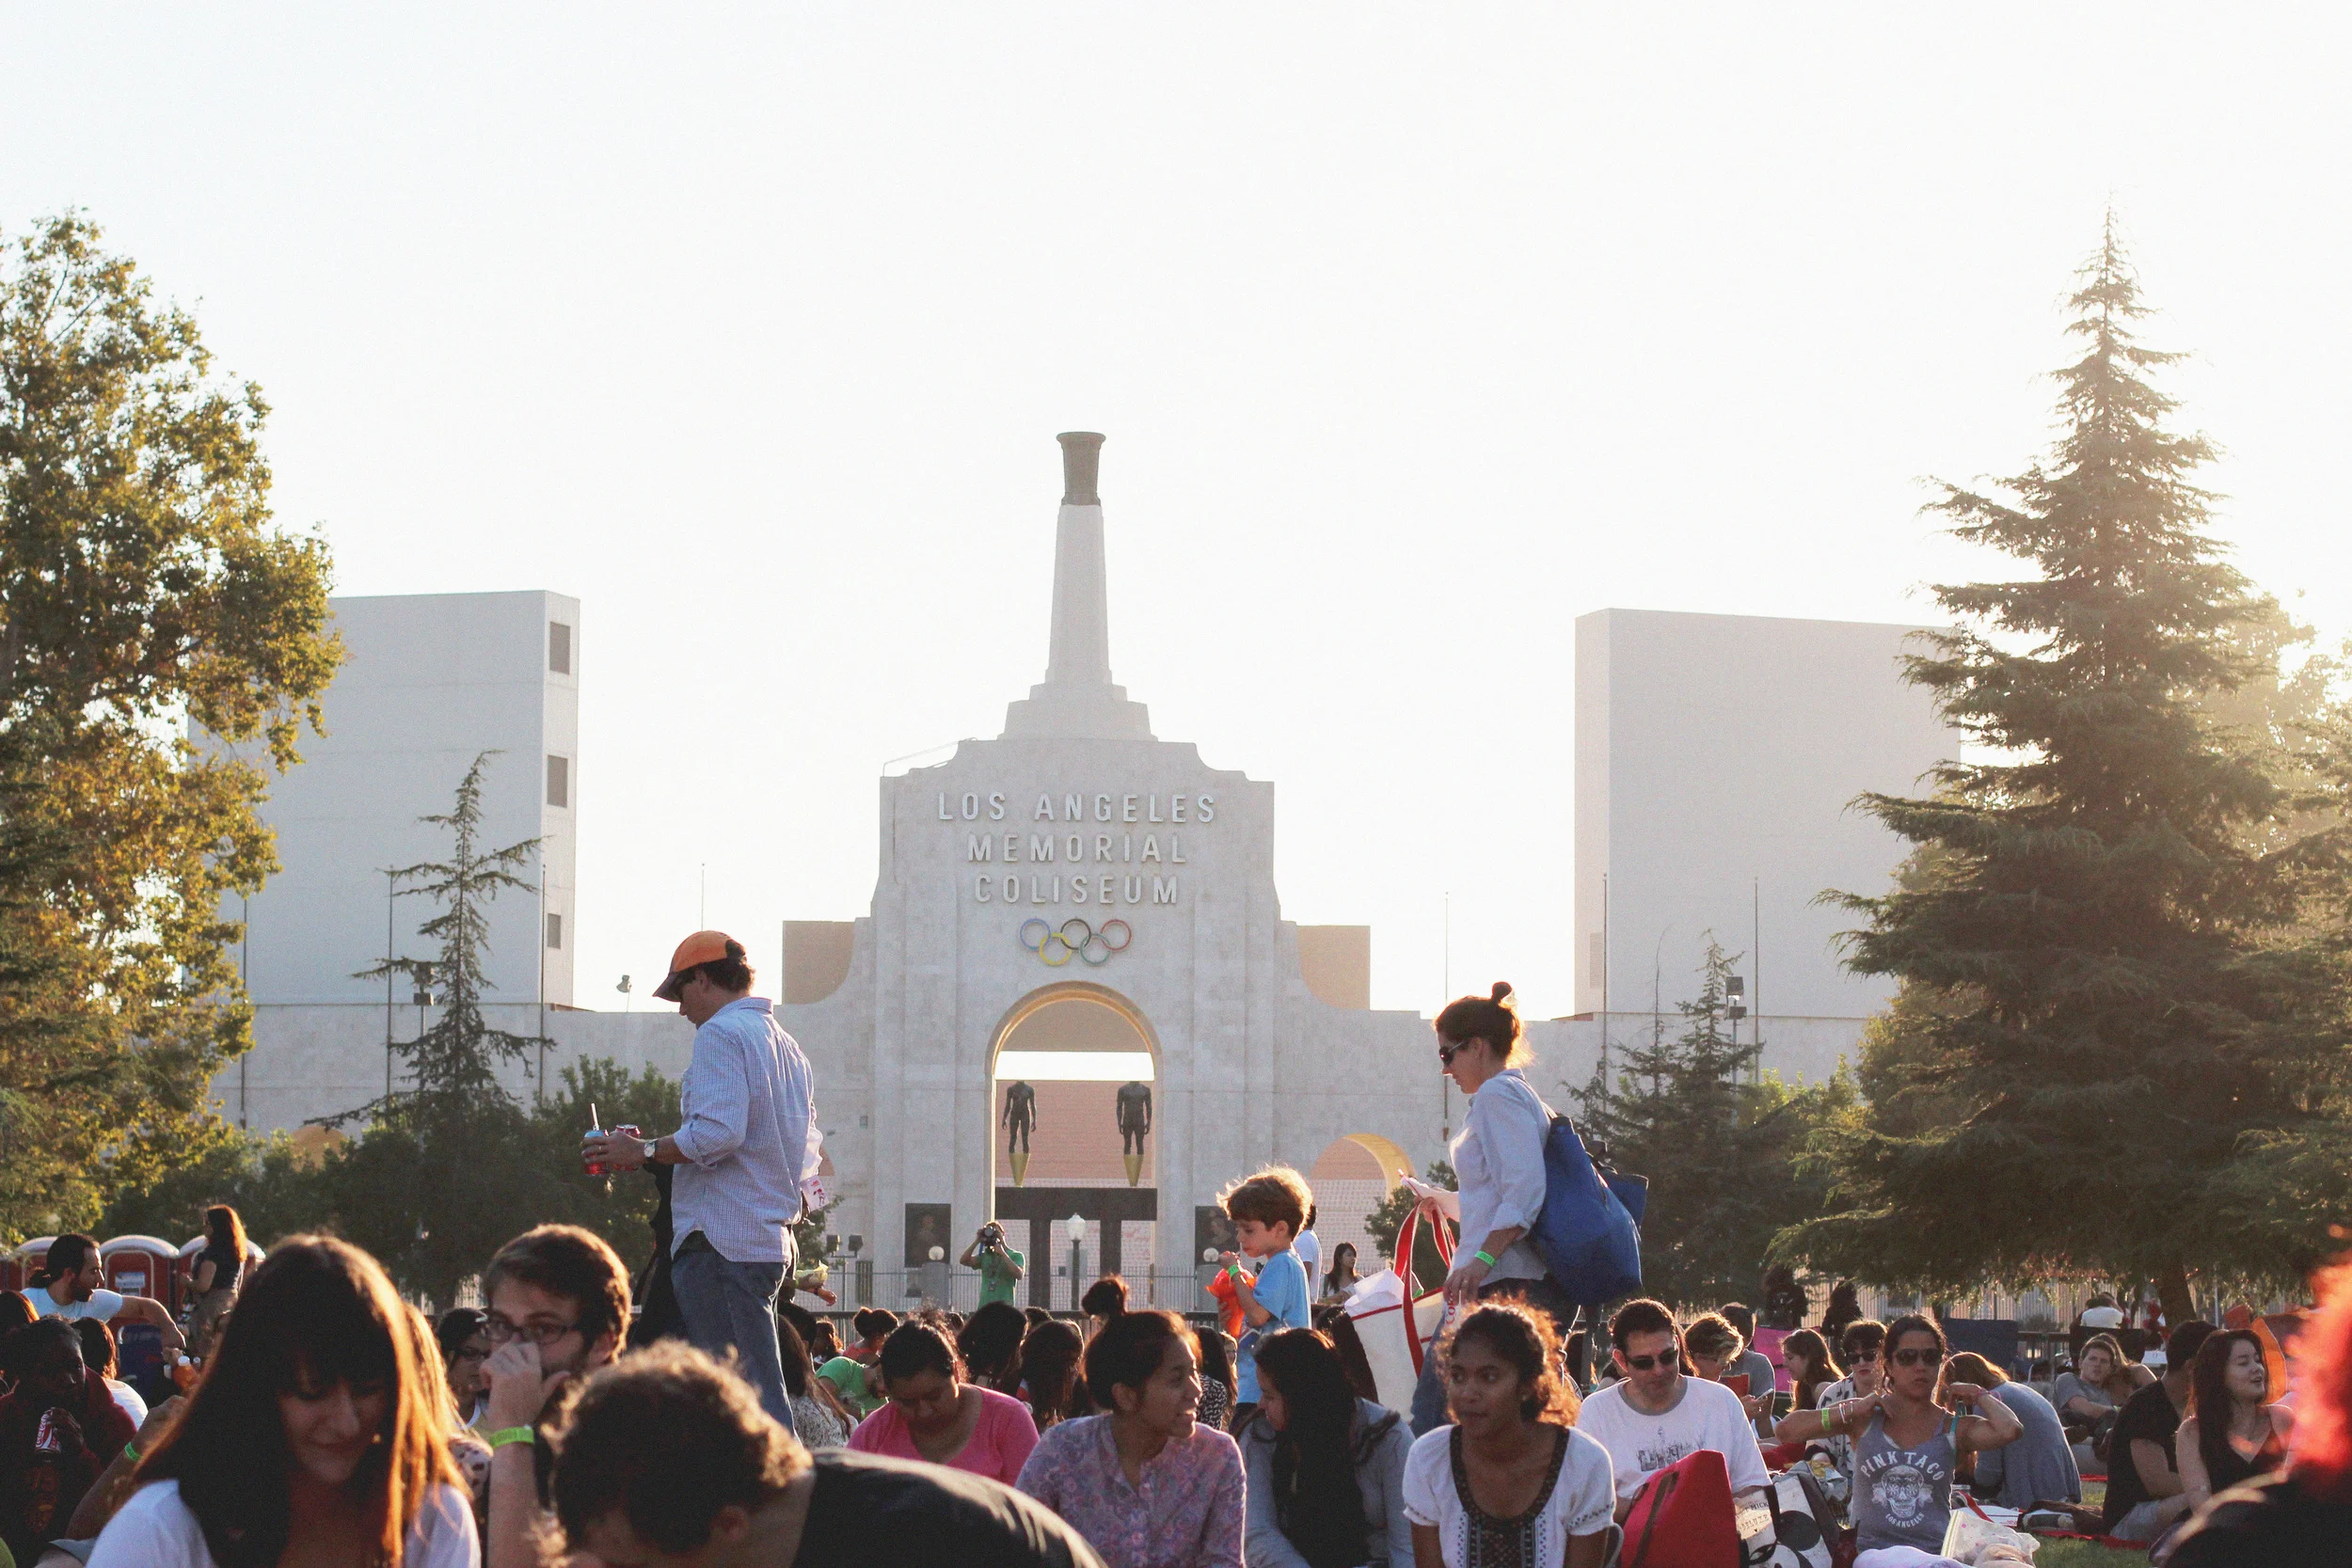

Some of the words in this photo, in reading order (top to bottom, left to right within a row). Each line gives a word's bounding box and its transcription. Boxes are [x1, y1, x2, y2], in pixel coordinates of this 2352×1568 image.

[939, 791, 1006, 820] LOS
[1034, 793, 1215, 823] ANGELES
[967, 833, 1186, 863] MEMORIAL
[975, 874, 1177, 904] COLISEUM
[1860, 1451, 1899, 1478] PINK
[1904, 1451, 1945, 1481] TACO
[1885, 1513, 1896, 1525] LOS
[1896, 1513, 1925, 1528] ANGELES
